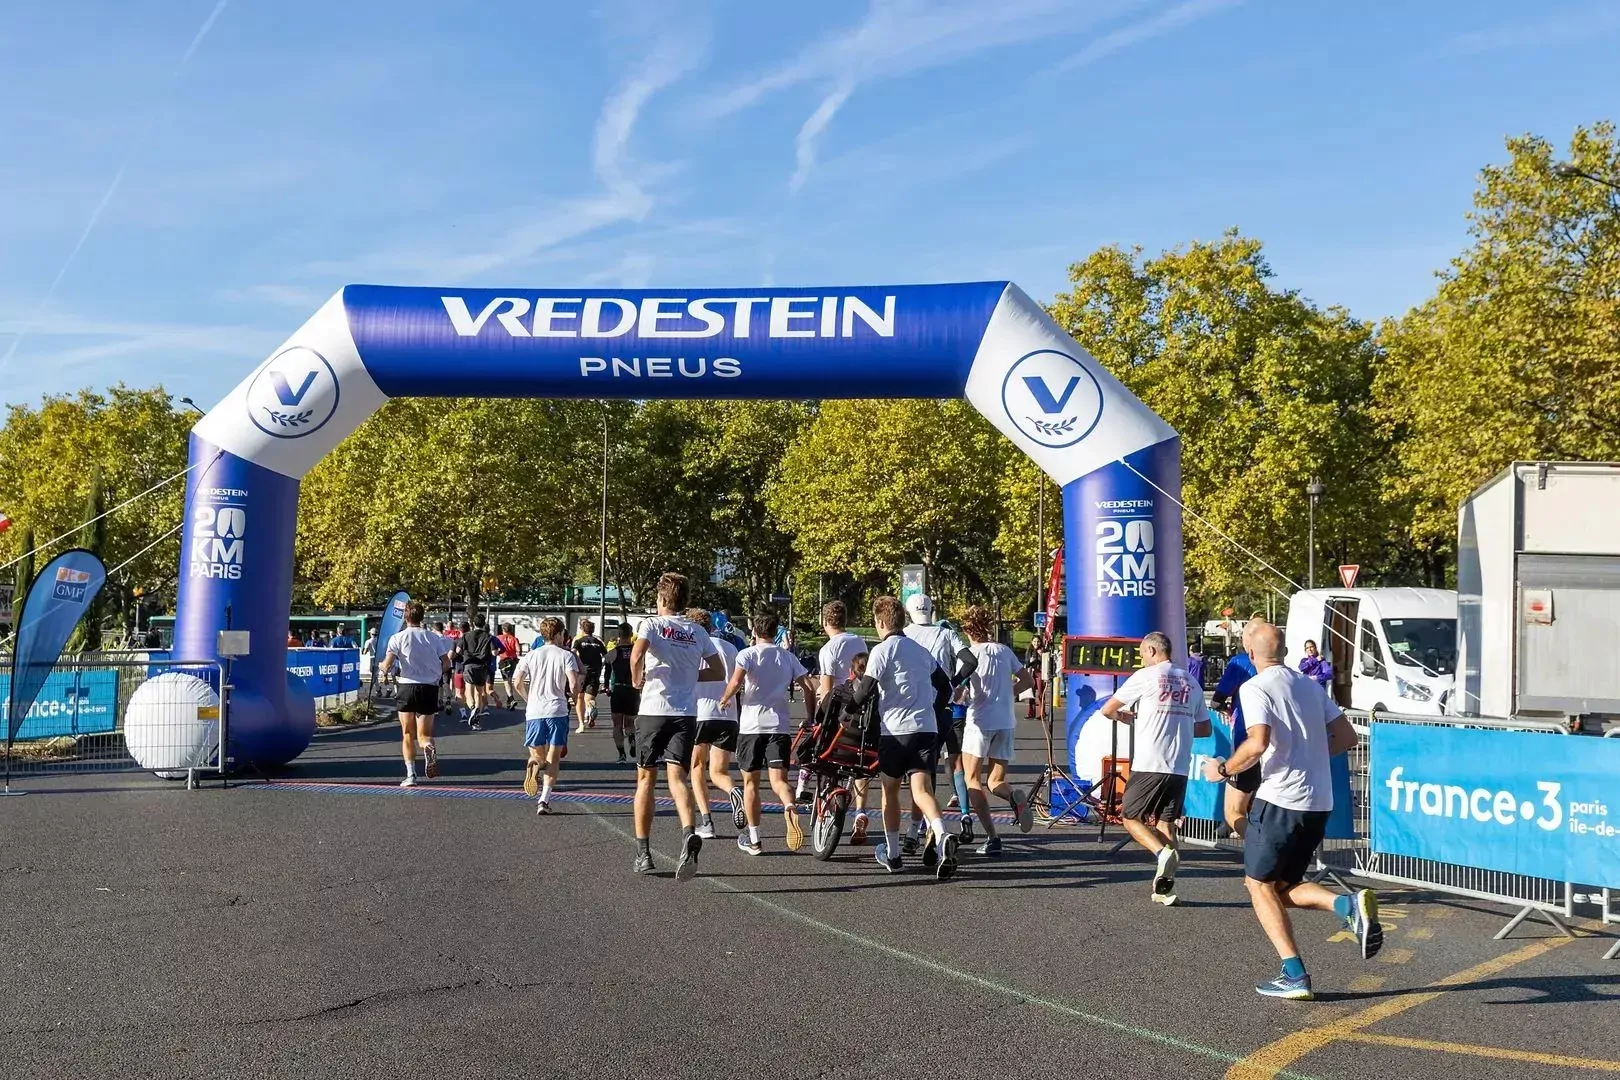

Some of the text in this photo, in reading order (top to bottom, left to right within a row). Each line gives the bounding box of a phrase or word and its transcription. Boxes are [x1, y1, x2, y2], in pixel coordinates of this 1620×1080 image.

[440, 295, 896, 338] VREDESTEIN
[580, 357, 742, 377] PNEUS
[1022, 376, 1081, 414] V
[1095, 500, 1153, 509] VREDESTEIN
[193, 507, 246, 538] 20
[1096, 520, 1154, 553] 20
[191, 538, 244, 564] KM
[190, 562, 242, 580] PARIS
[1096, 554, 1156, 580] KM
[56, 585, 85, 598] GMF
[1096, 580, 1156, 597] PARIS
[1570, 800, 1608, 817] paris
